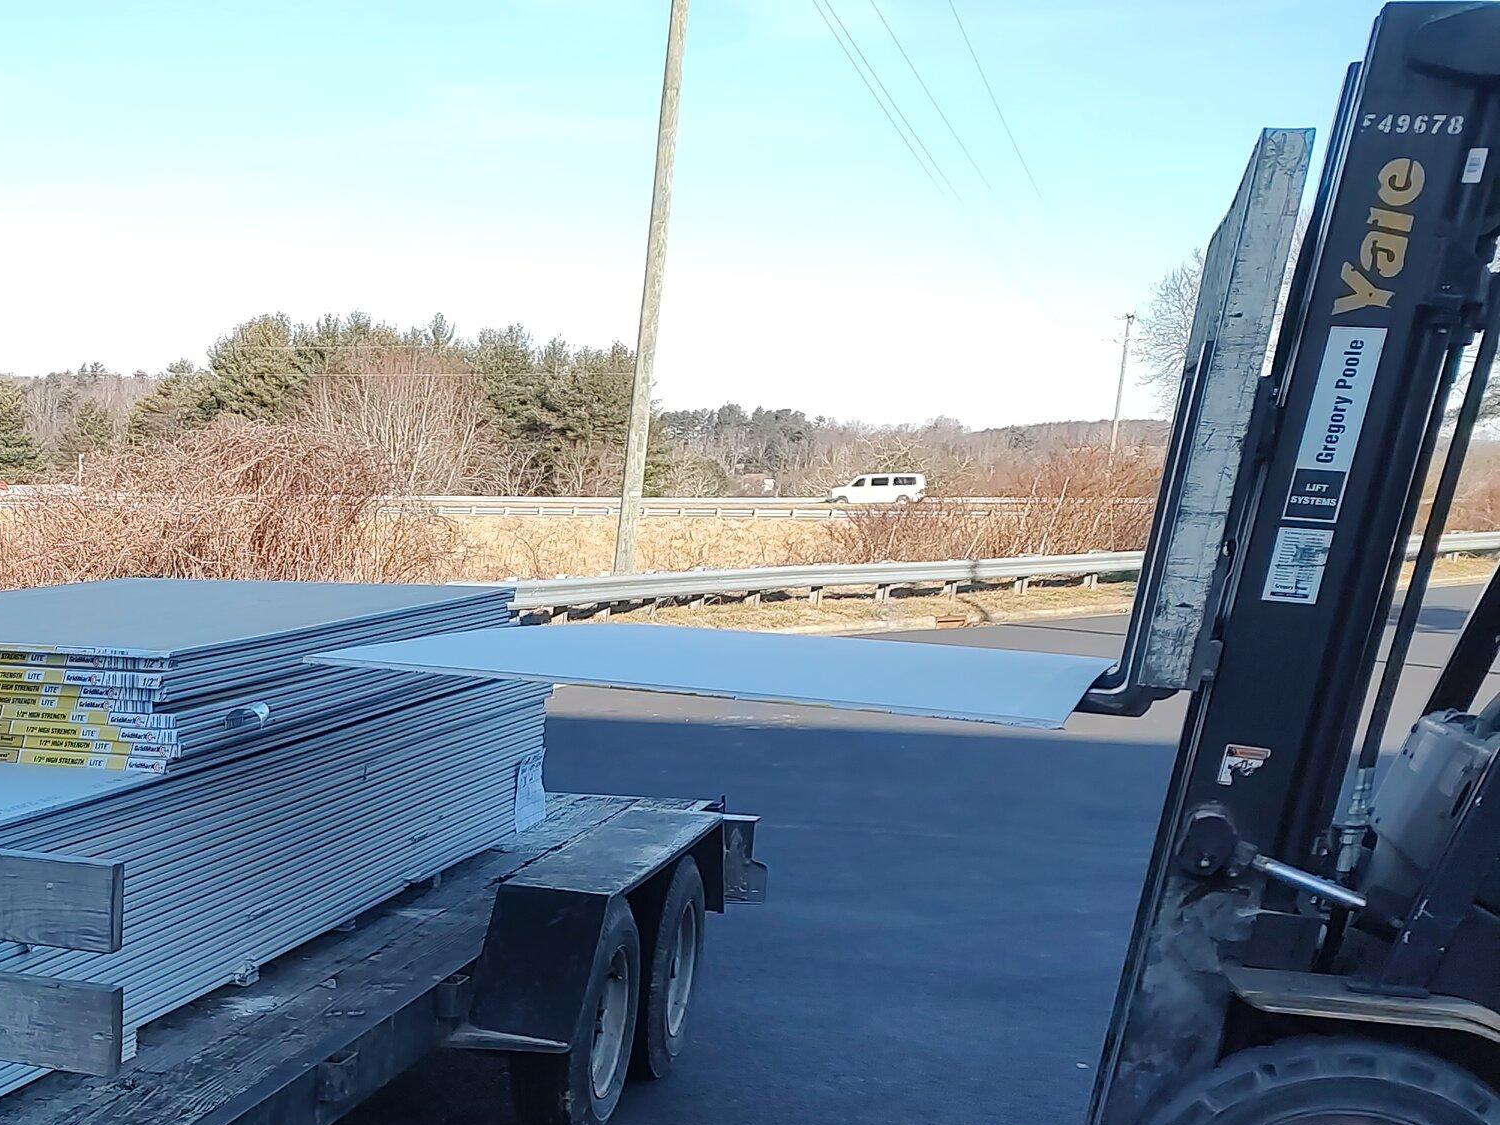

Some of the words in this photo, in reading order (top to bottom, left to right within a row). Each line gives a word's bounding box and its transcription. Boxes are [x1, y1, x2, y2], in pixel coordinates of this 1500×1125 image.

[1361, 114, 1465, 135] F49678
[1331, 158, 1426, 316] Yale
[1334, 339, 1365, 390] Poole
[1315, 395, 1354, 464] Gregory
[1305, 483, 1330, 493] LIFT
[1290, 495, 1337, 507] SYSTEMS
[1, 653, 26, 661] STRENGTH
[31, 654, 45, 662] LITE
[14, 684, 40, 692] STRENGTH
[41, 712, 67, 720] STRENGTH
[71, 714, 84, 722] LITE
[81, 729, 95, 737] LITE
[64, 741, 90, 749] STRENGTH
